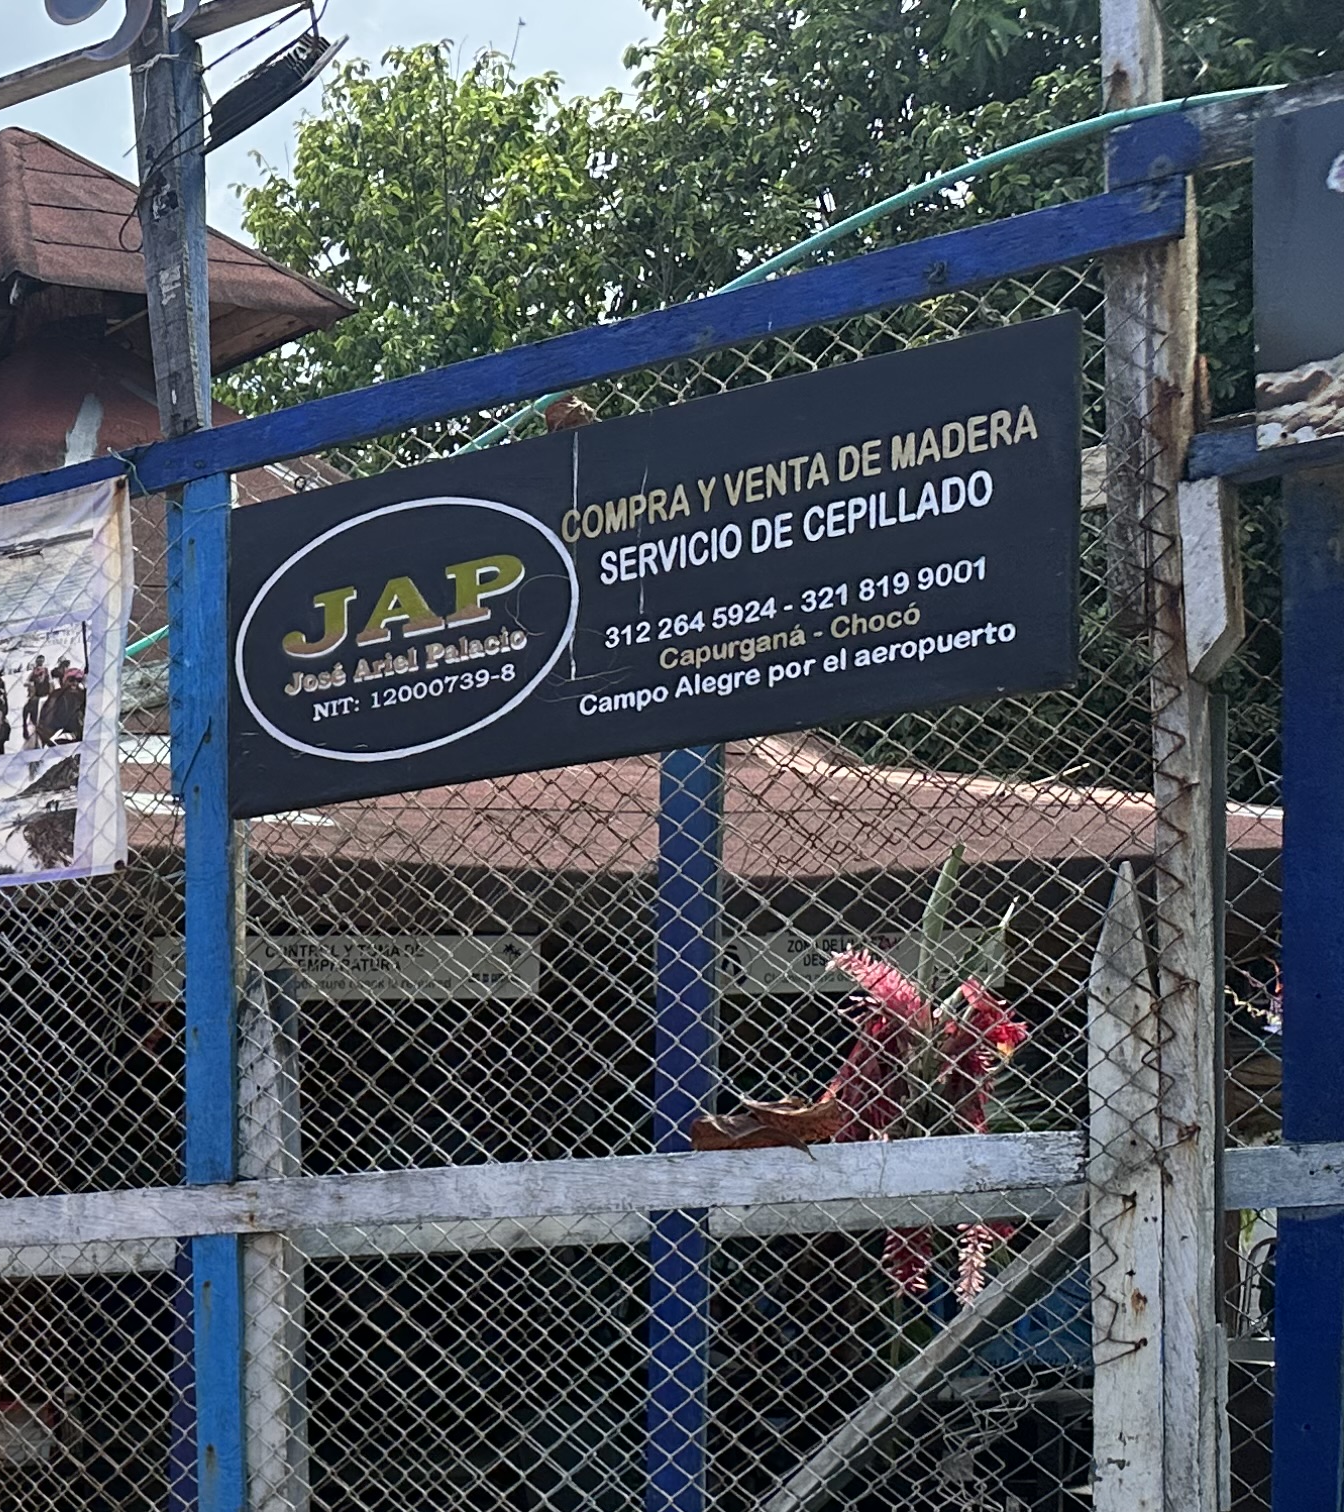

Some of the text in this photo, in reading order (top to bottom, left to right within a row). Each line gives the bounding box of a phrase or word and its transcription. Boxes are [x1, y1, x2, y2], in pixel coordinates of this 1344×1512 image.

[562, 404, 1039, 543] COMPRA Y VENTA DE MADERA
[600, 470, 994, 585] SERVICIO DE CEPILLADO
[281, 554, 526, 658] JAP
[604, 621, 652, 649] 312
[657, 610, 706, 640] 264
[712, 596, 778, 630] 5924
[800, 583, 848, 613] 321
[858, 571, 911, 602] 819
[917, 555, 987, 591] 9001
[659, 624, 807, 670] Capurganá
[830, 602, 921, 639] Chocó
[284, 626, 528, 696] José Ariel Palacio
[312, 663, 517, 721] NIT: 12000739-8
[579, 622, 1017, 717] Campo Alegre por el aeropuerto
